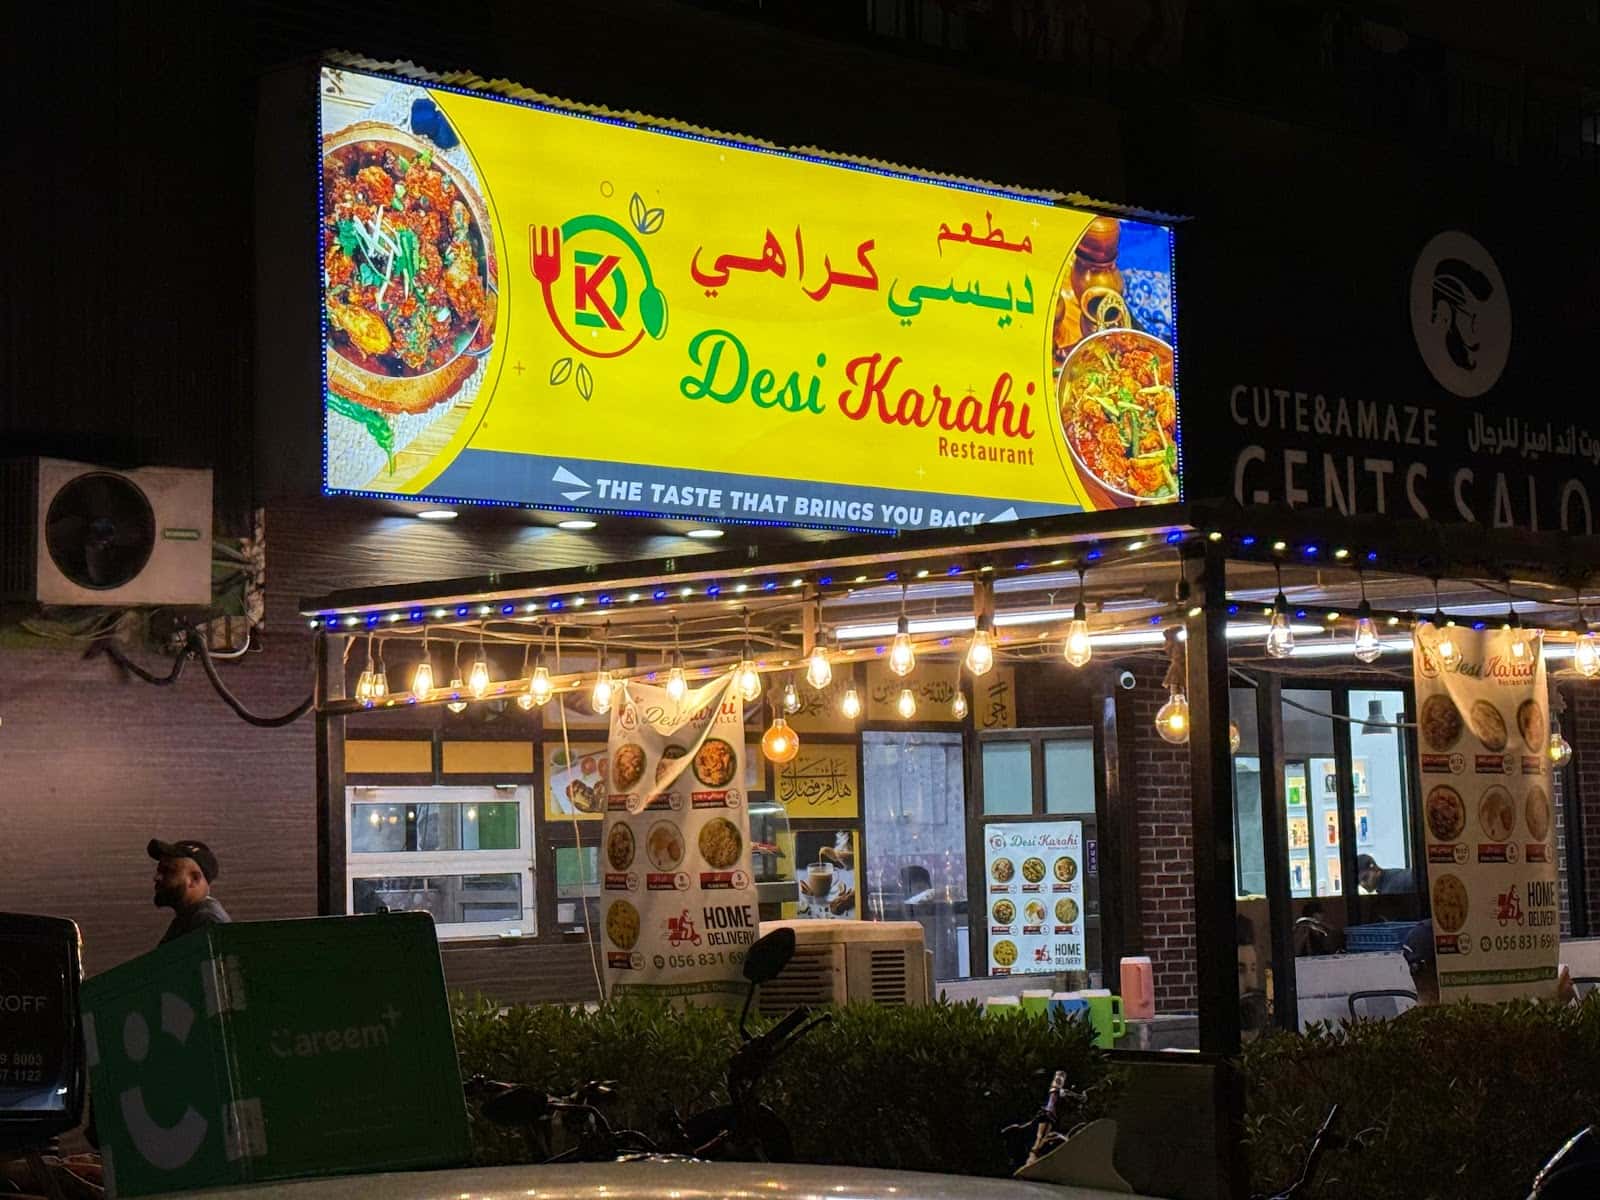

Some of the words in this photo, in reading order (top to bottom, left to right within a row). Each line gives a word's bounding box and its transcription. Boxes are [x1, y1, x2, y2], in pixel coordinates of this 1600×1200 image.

[937, 209, 1034, 258] مطعم
[690, 222, 879, 301] كراهي
[887, 273, 1035, 327] ديسي
[680, 328, 826, 415] Desi
[838, 352, 1035, 440] Karahi
[1230, 384, 1439, 448] CUTE&AMAZE
[938, 436, 1034, 466] Restaurant
[596, 478, 642, 504] THE
[651, 483, 722, 508] TASTE
[730, 491, 788, 513] THAT
[795, 496, 875, 522] BRINGS
[880, 502, 924, 526] YOU
[929, 508, 985, 528] BACK
[1528, 881, 1555, 907] HOME
[703, 905, 754, 930] HOME
[707, 931, 754, 946] DELIVERY
[1055, 943, 1081, 956] HOME
[1495, 936, 1517, 951] 056
[1519, 934, 1537, 950] 831
[669, 953, 695, 969] 056
[698, 951, 724, 967] 831
[1055, 956, 1081, 965] DELIVERY
